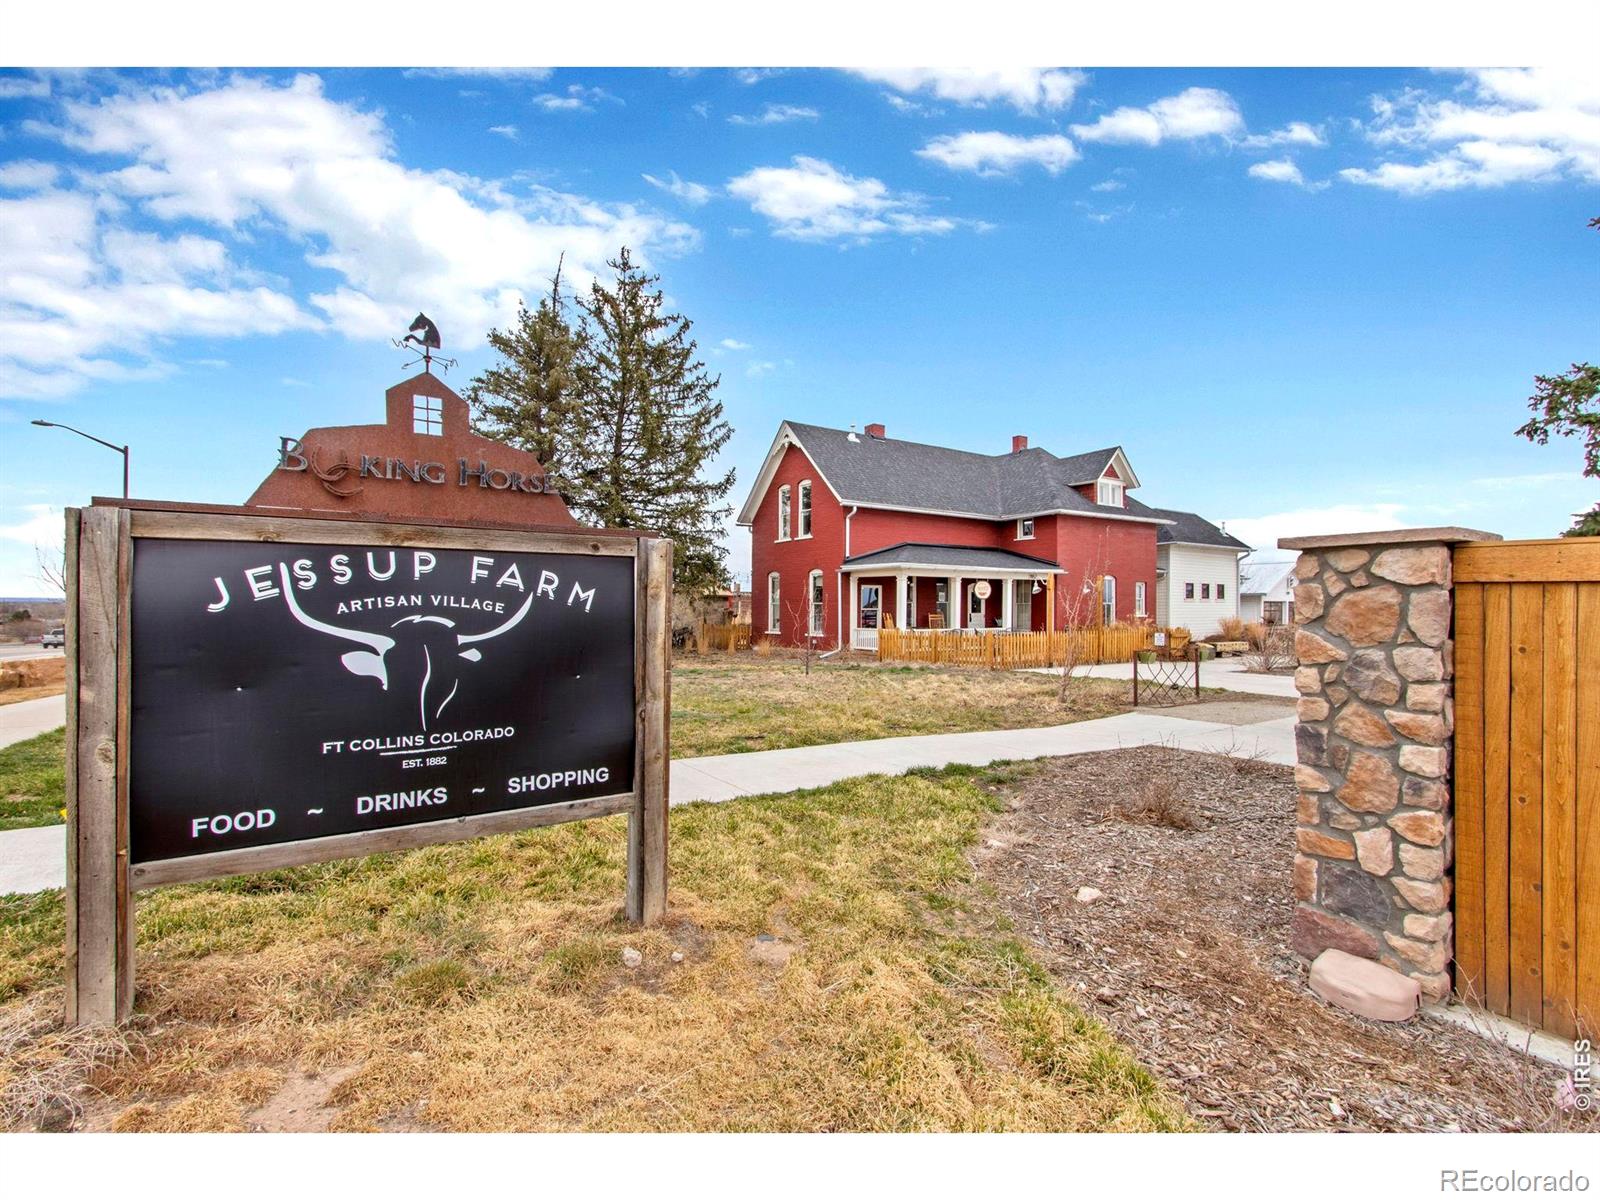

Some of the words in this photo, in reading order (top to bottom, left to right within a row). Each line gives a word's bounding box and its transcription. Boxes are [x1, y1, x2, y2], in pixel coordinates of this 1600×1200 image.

[457, 456, 560, 495] HORSE
[207, 551, 437, 613] JESSUP
[470, 555, 597, 614] FARM
[336, 594, 422, 615] ARTISAN
[431, 594, 506, 614] VILLAGE
[322, 741, 345, 755] FT
[349, 734, 425, 752] COLLINS
[430, 726, 516, 745] COLORADO
[402, 759, 424, 769] EST.
[426, 756, 448, 767] 1882
[191, 808, 277, 838] FOOD
[356, 787, 449, 815] DRINKS
[507, 767, 610, 794] SHOPPING
